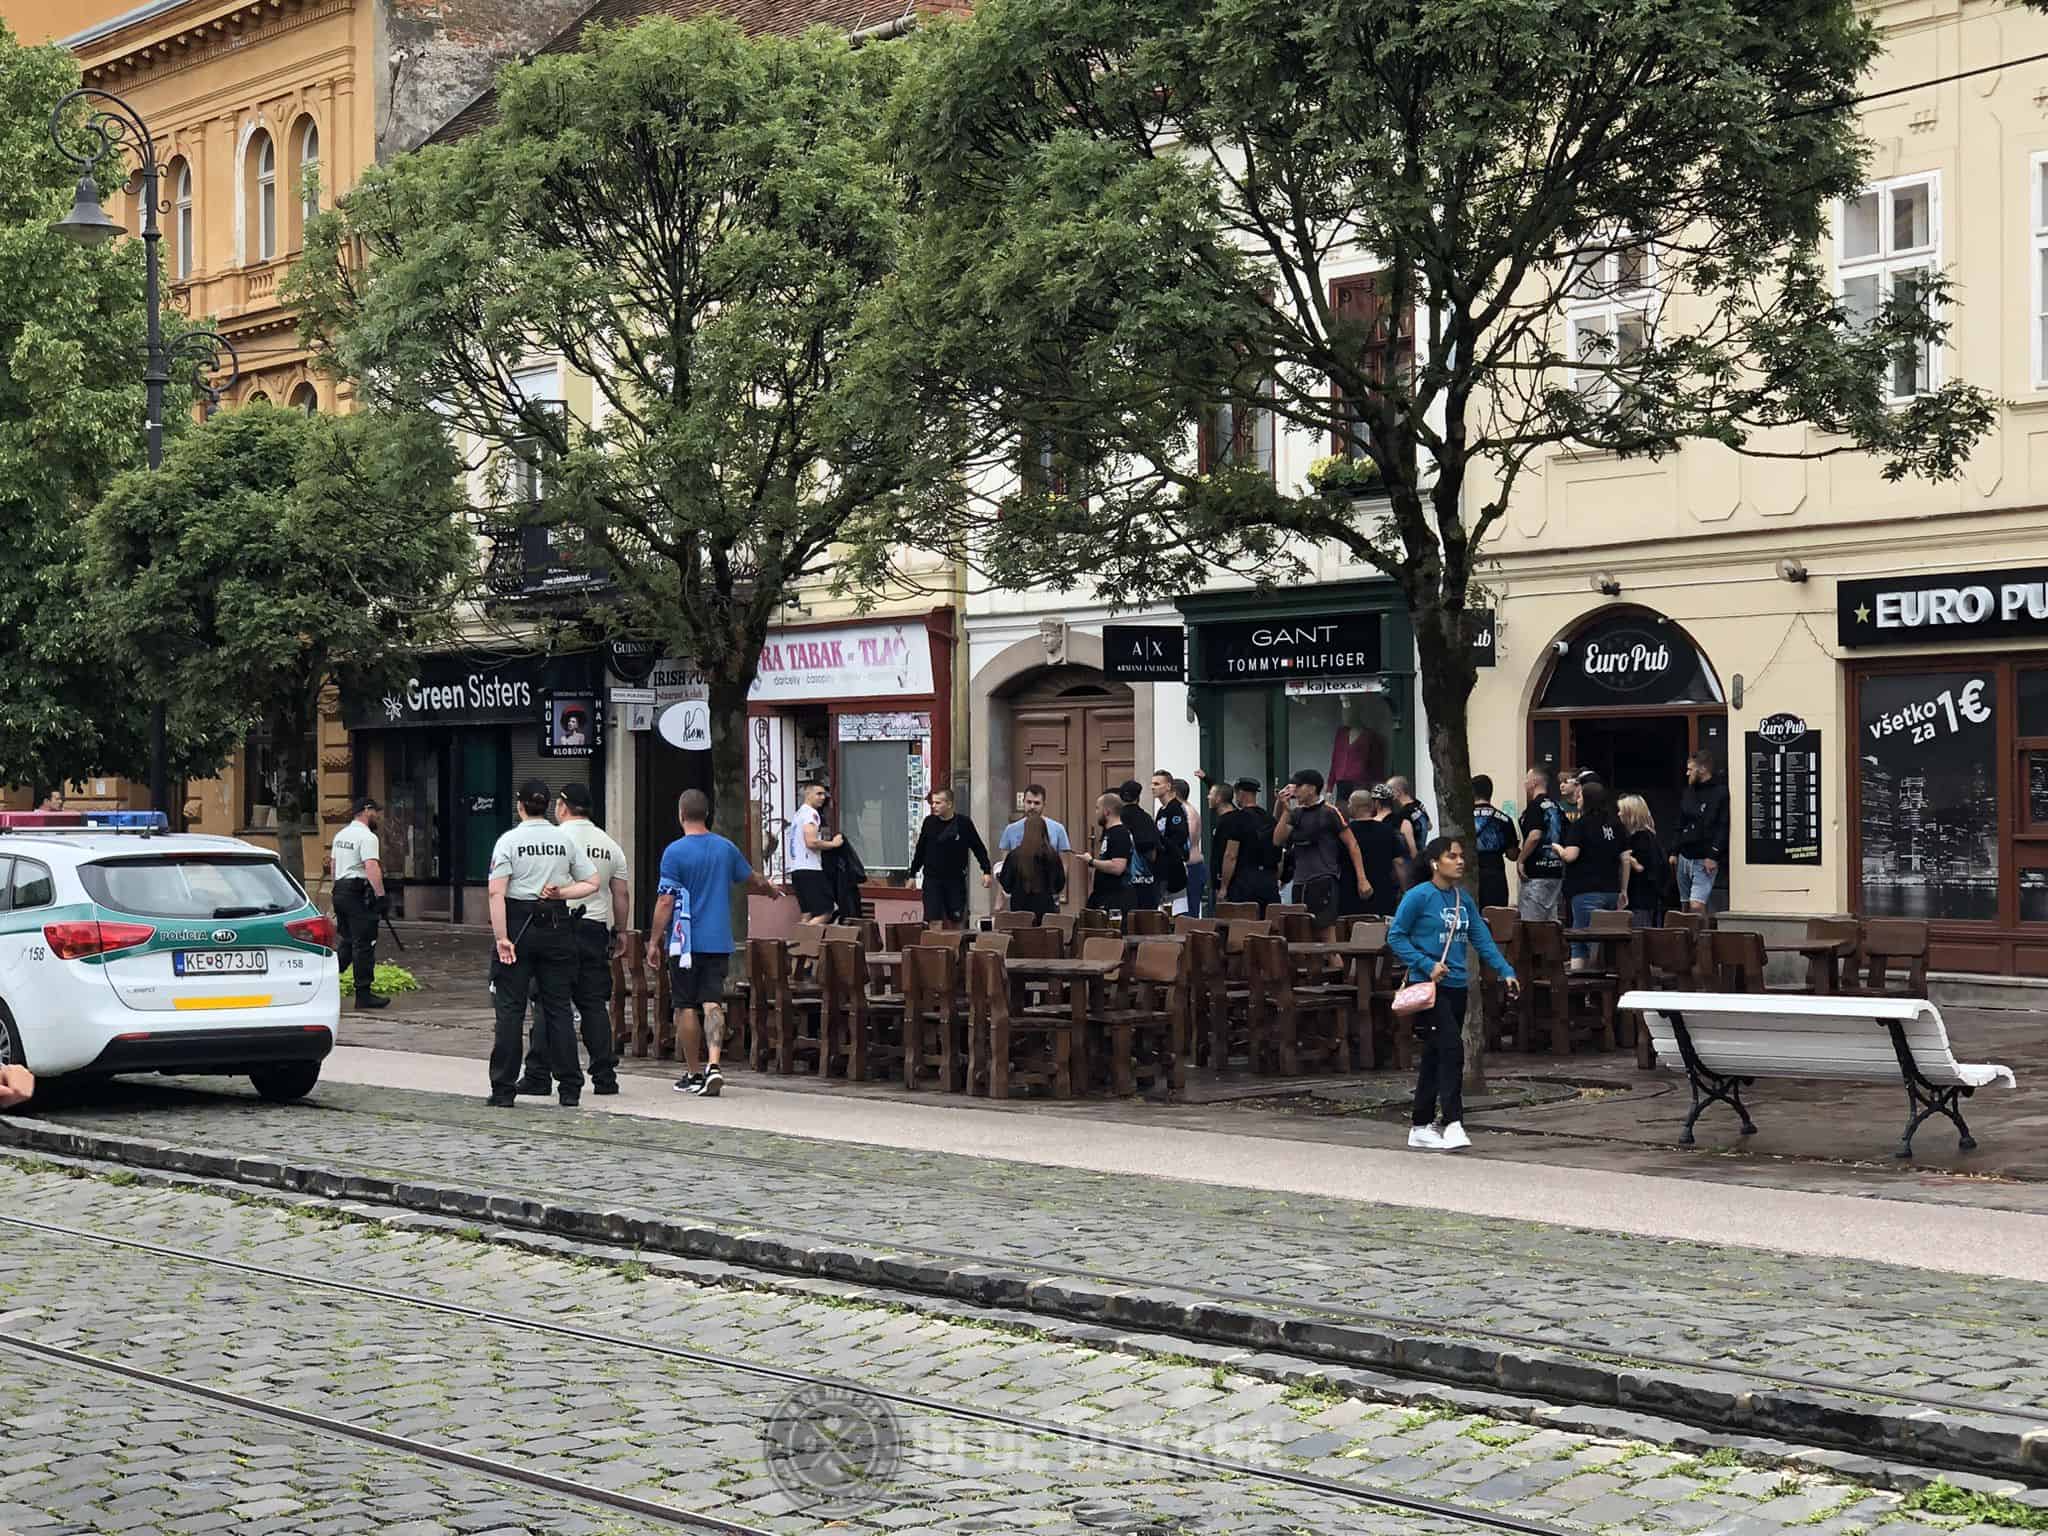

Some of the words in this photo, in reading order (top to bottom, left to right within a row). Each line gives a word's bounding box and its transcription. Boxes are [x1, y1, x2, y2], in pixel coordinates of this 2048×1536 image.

[1876, 586, 1995, 628] EURO
[1252, 625, 1338, 647] GANT
[760, 645, 784, 672] RA
[786, 640, 845, 670] TABAK
[1228, 657, 1280, 673] TOMMY
[1296, 652, 1366, 669] HILFIGER
[1585, 643, 1630, 674] Euro
[1631, 643, 1669, 672] Pub
[654, 671, 686, 687] IRISH
[1307, 680, 1364, 693] kajtex.sk
[407, 678, 465, 711] Green
[468, 674, 531, 708] Sisters
[1937, 679, 1991, 733] 1€
[1760, 719, 1784, 735] Euro
[1784, 719, 1805, 735] Pub
[1869, 701, 1937, 739] všetko
[1911, 722, 1937, 744] za
[518, 842, 566, 857] POLÍCIA
[160, 928, 208, 941] POLÍCIA
[29, 947, 45, 961] 158
[287, 959, 304, 969] 158
